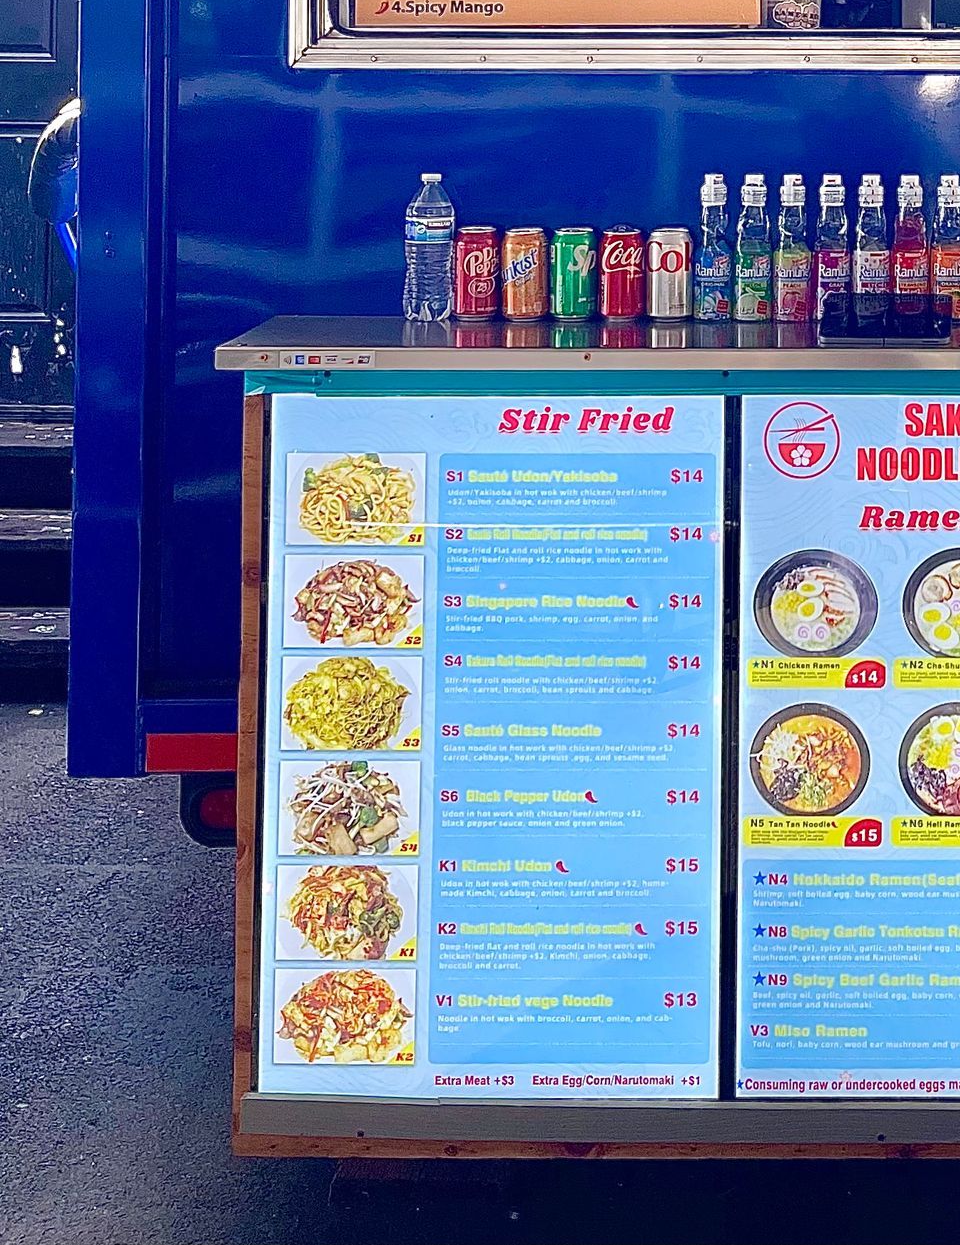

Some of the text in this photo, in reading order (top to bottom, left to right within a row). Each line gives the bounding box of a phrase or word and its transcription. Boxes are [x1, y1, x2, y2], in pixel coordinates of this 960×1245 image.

[392, 1, 504, 16] 4.Spicy Mango
[499, 406, 675, 433] Stir Fried
[446, 469, 703, 484] S1 $14
[444, 594, 701, 609] S3 $14
[761, 661, 774, 669] N1
[851, 671, 877, 684] $14
[910, 820, 923, 828] N6
[436, 993, 697, 1008] V1 $13
[750, 1025, 769, 1037] V3
[435, 1075, 700, 1088] Extra Meat +$3 Extra Egg/Corn/Narutomaki +$1
[745, 1079, 805, 1092] Consuming
[808, 1080, 828, 1090] raw
[831, 1080, 842, 1090] or
[845, 1079, 915, 1091] undercooked
[919, 1081, 945, 1093] eggs
